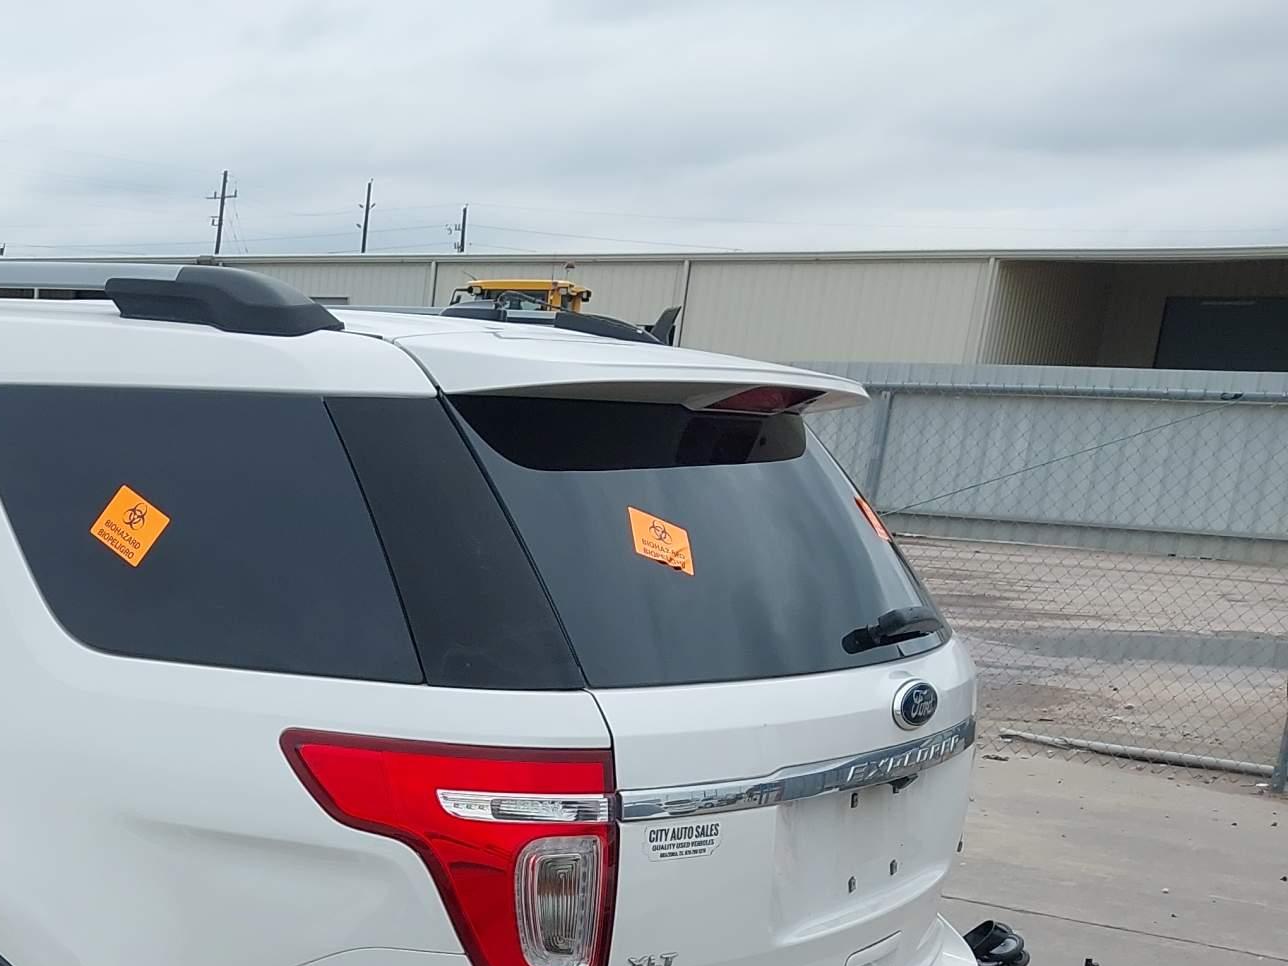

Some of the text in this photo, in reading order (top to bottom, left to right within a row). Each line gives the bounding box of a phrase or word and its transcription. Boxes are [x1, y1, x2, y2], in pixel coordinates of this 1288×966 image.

[97, 528, 135, 560] BIOPELIGRO
[104, 519, 141, 550] BIOHAZARD
[649, 823, 720, 843] CITY AUTO SALES
[652, 839, 715, 852] QUALITY USED VEHICLES
